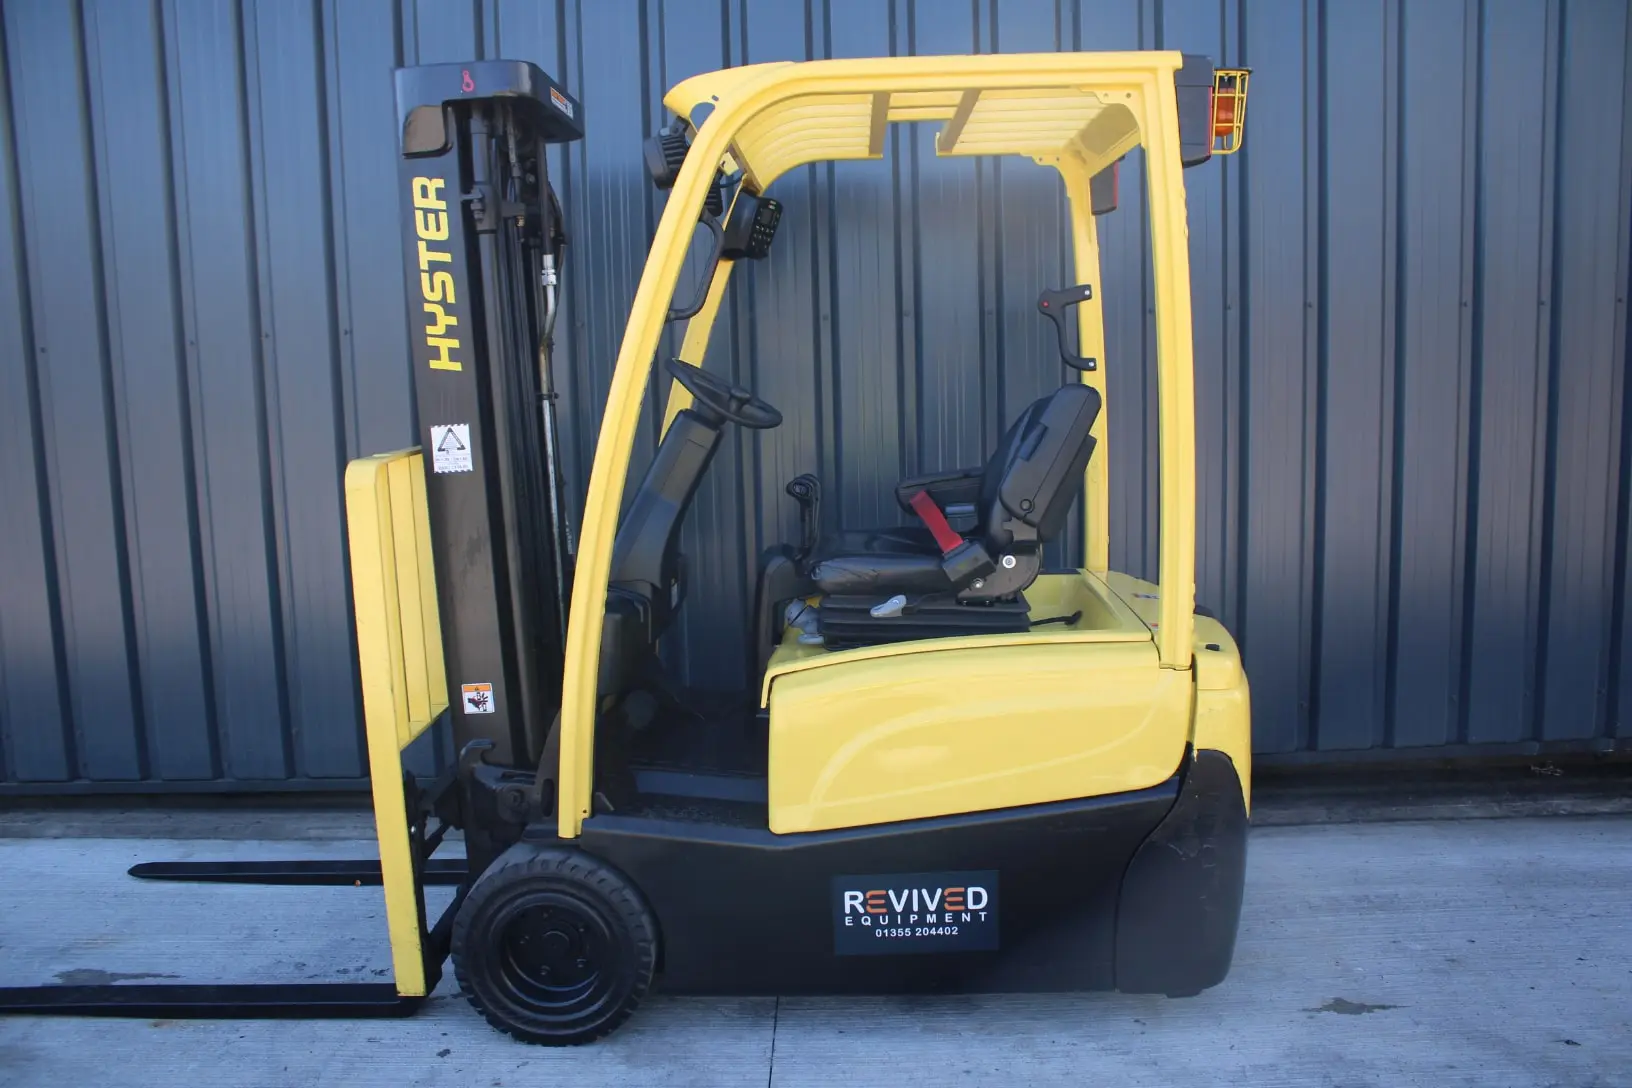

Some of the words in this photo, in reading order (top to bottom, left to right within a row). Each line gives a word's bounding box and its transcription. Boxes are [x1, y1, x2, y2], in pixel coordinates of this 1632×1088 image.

[412, 176, 463, 372] HYSTER
[843, 886, 989, 914] REVIVED
[844, 911, 988, 926] EQUIPMENT
[875, 928, 912, 938] 01355
[915, 926, 959, 937] 204402
